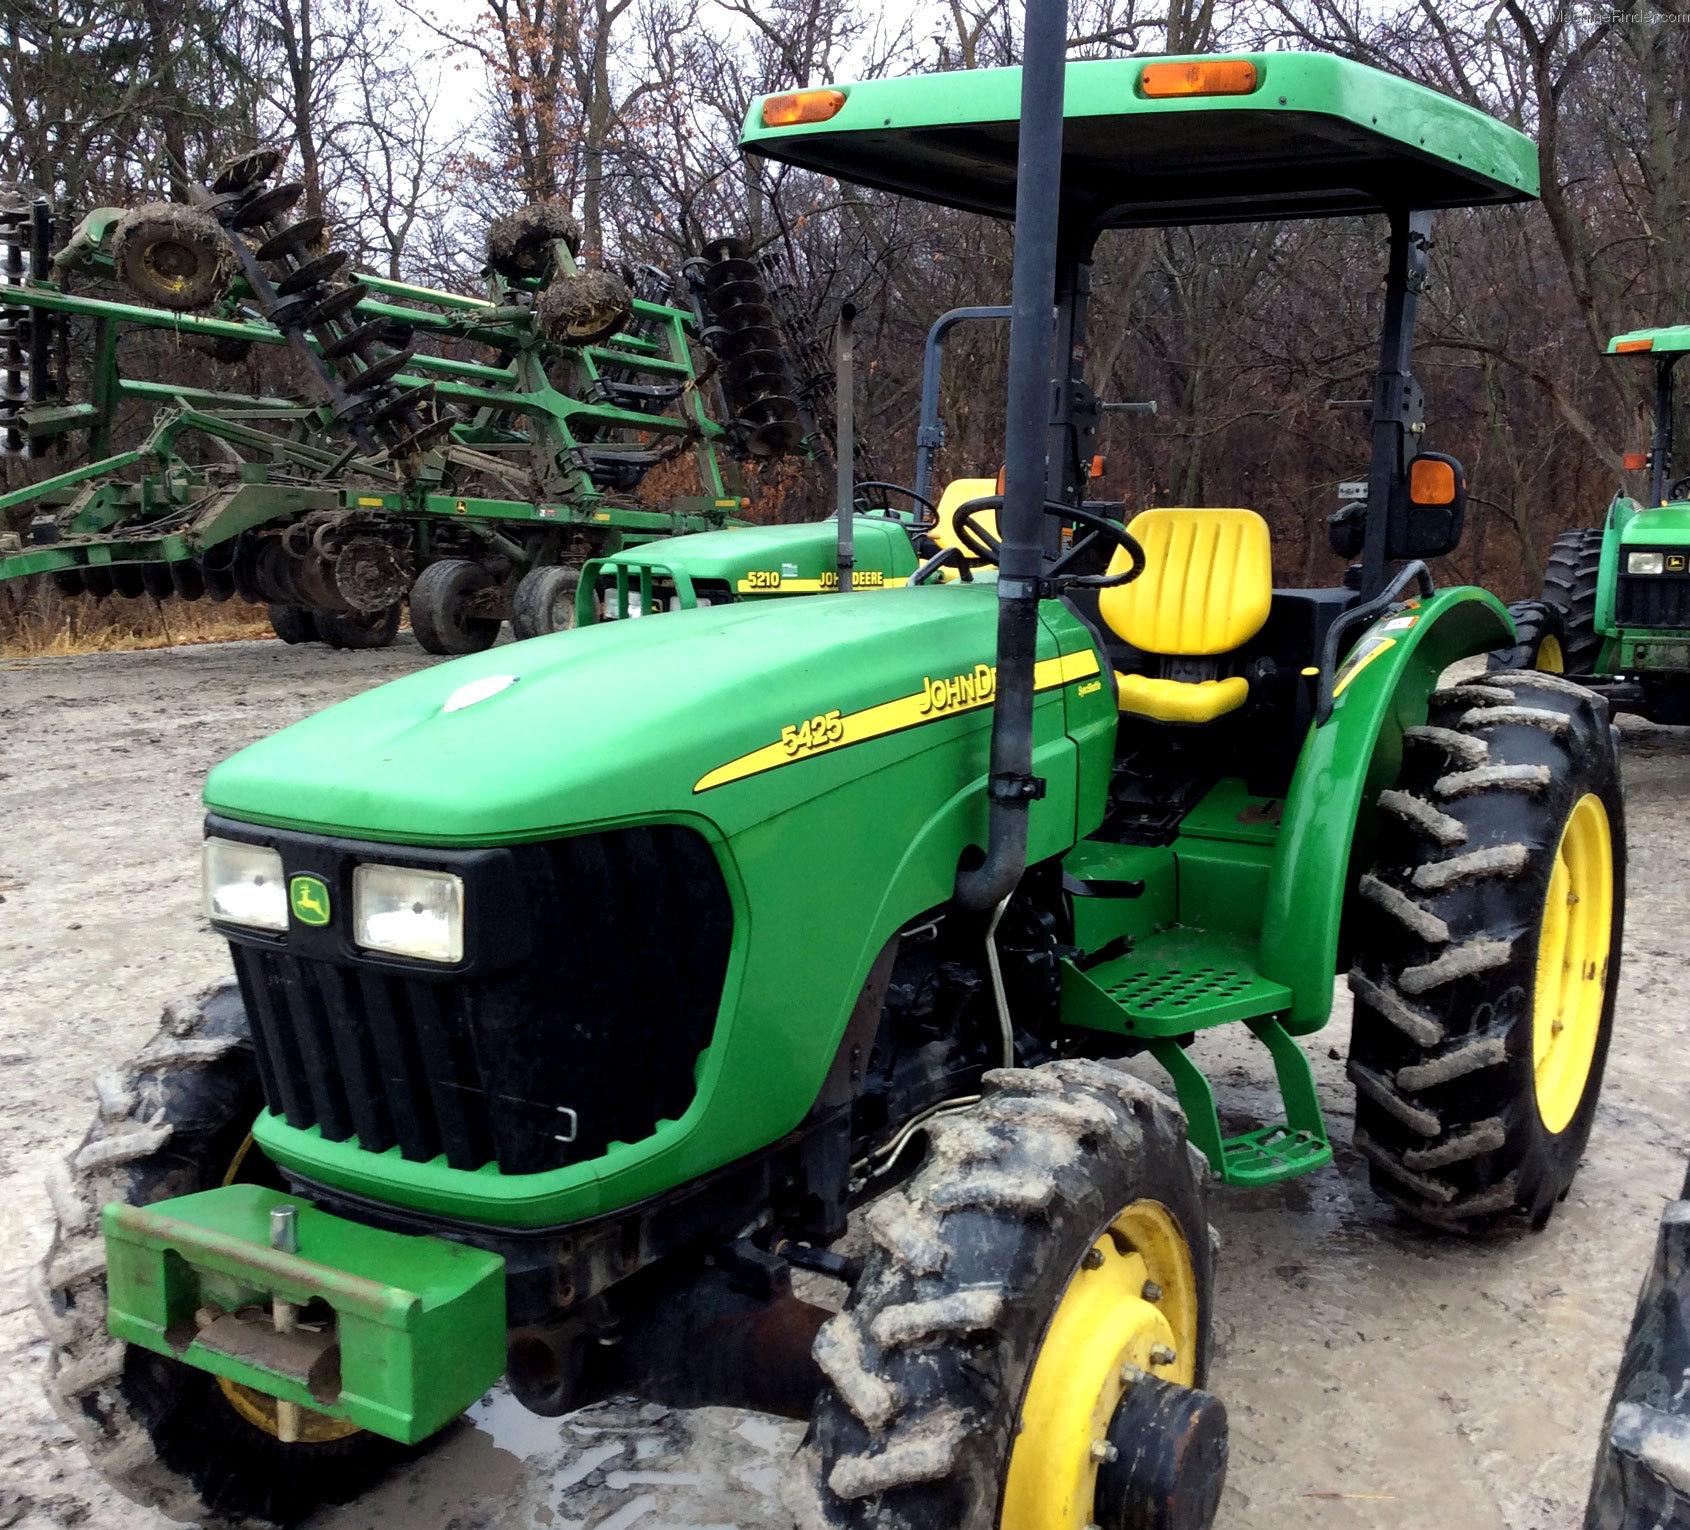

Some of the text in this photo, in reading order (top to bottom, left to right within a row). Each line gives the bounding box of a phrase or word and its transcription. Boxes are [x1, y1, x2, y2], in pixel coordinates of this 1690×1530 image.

[747, 570, 780, 589] 5210
[819, 571, 884, 588] JOH DEERE
[781, 709, 844, 757] 5425
